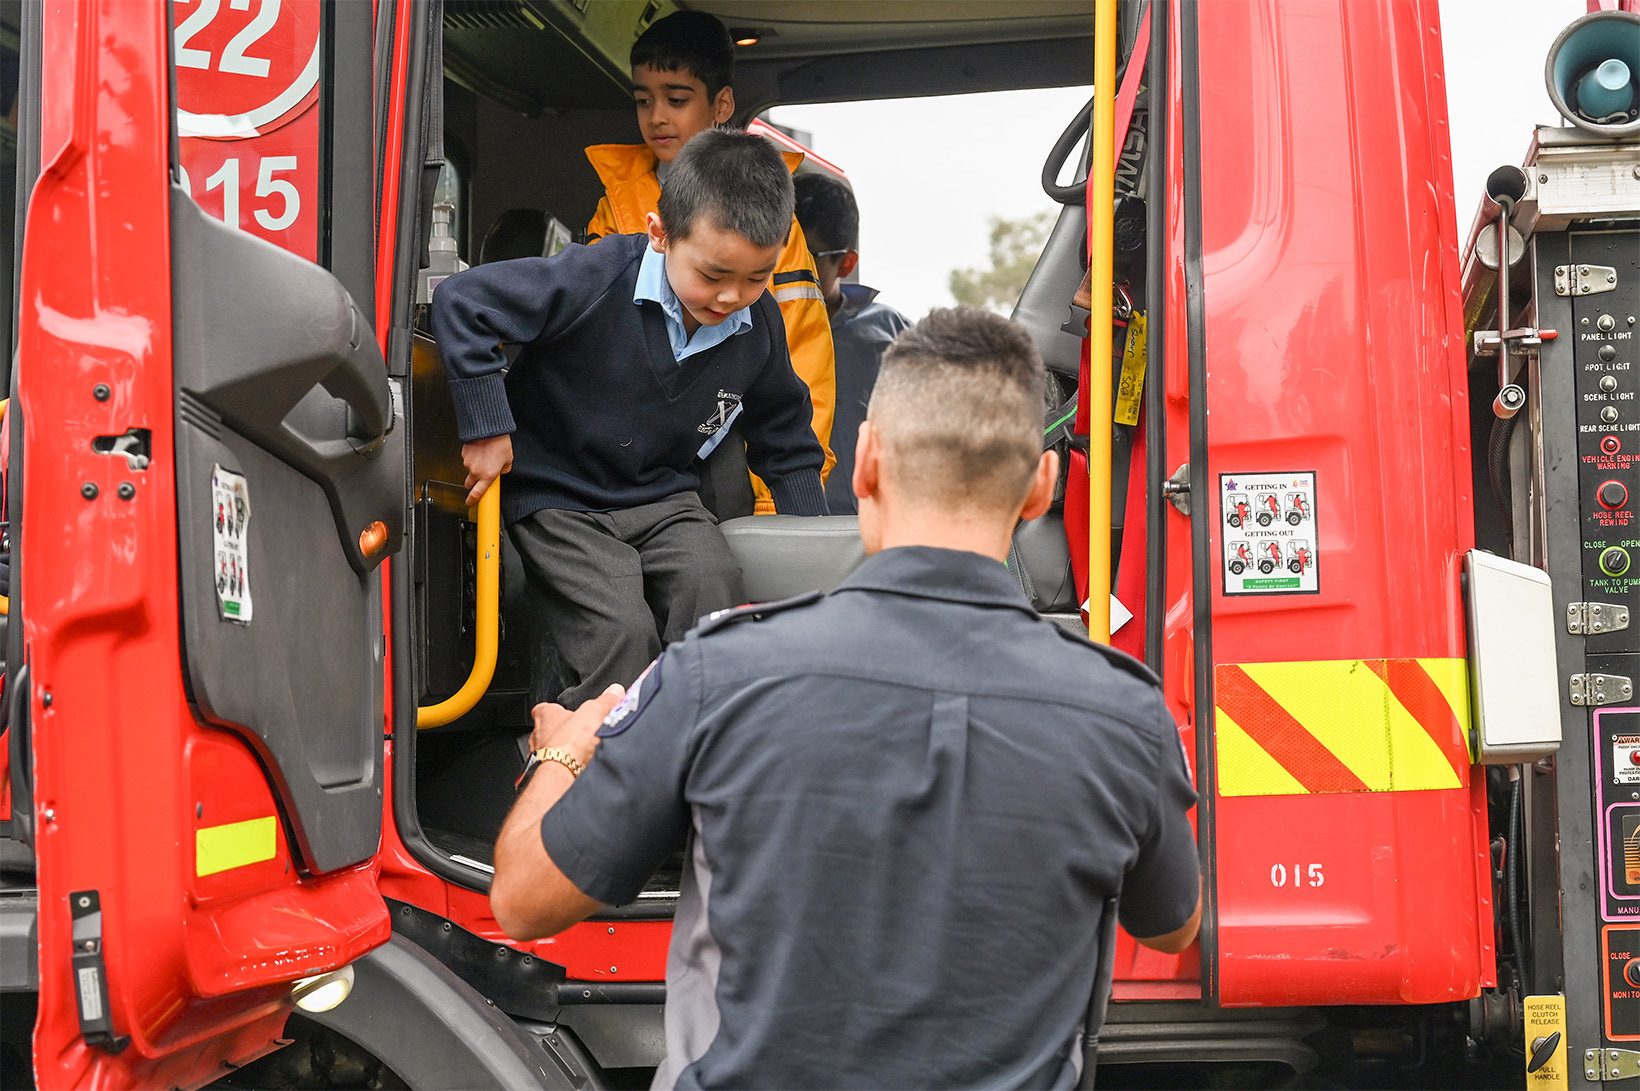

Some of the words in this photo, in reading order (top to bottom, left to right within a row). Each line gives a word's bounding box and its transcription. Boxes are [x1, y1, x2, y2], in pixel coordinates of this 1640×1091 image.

[174, 0, 271, 78] 22
[179, 155, 301, 231] 15
[1581, 333, 1605, 341] PANEL
[1607, 332, 1632, 340] LIGHT
[1584, 363, 1604, 371] SPOT
[1606, 362, 1631, 370] LIGHT
[1583, 393, 1608, 401] SCENE
[1610, 392, 1634, 400] LIGHT
[1598, 424, 1618, 432] SCENE
[1620, 423, 1640, 431] LIGHT
[1582, 455, 1615, 463] VEHICLE
[1593, 511, 1613, 519] HOSE
[1600, 518, 1629, 526] REWIND
[1584, 541, 1607, 549] CLOSE
[1621, 540, 1640, 548] OPEN
[1590, 579, 1609, 587] TANK
[1612, 578, 1621, 586] TO
[1605, 585, 1629, 594] VALVE
[1271, 863, 1324, 887] 015
[1611, 952, 1631, 960] CLOSE
